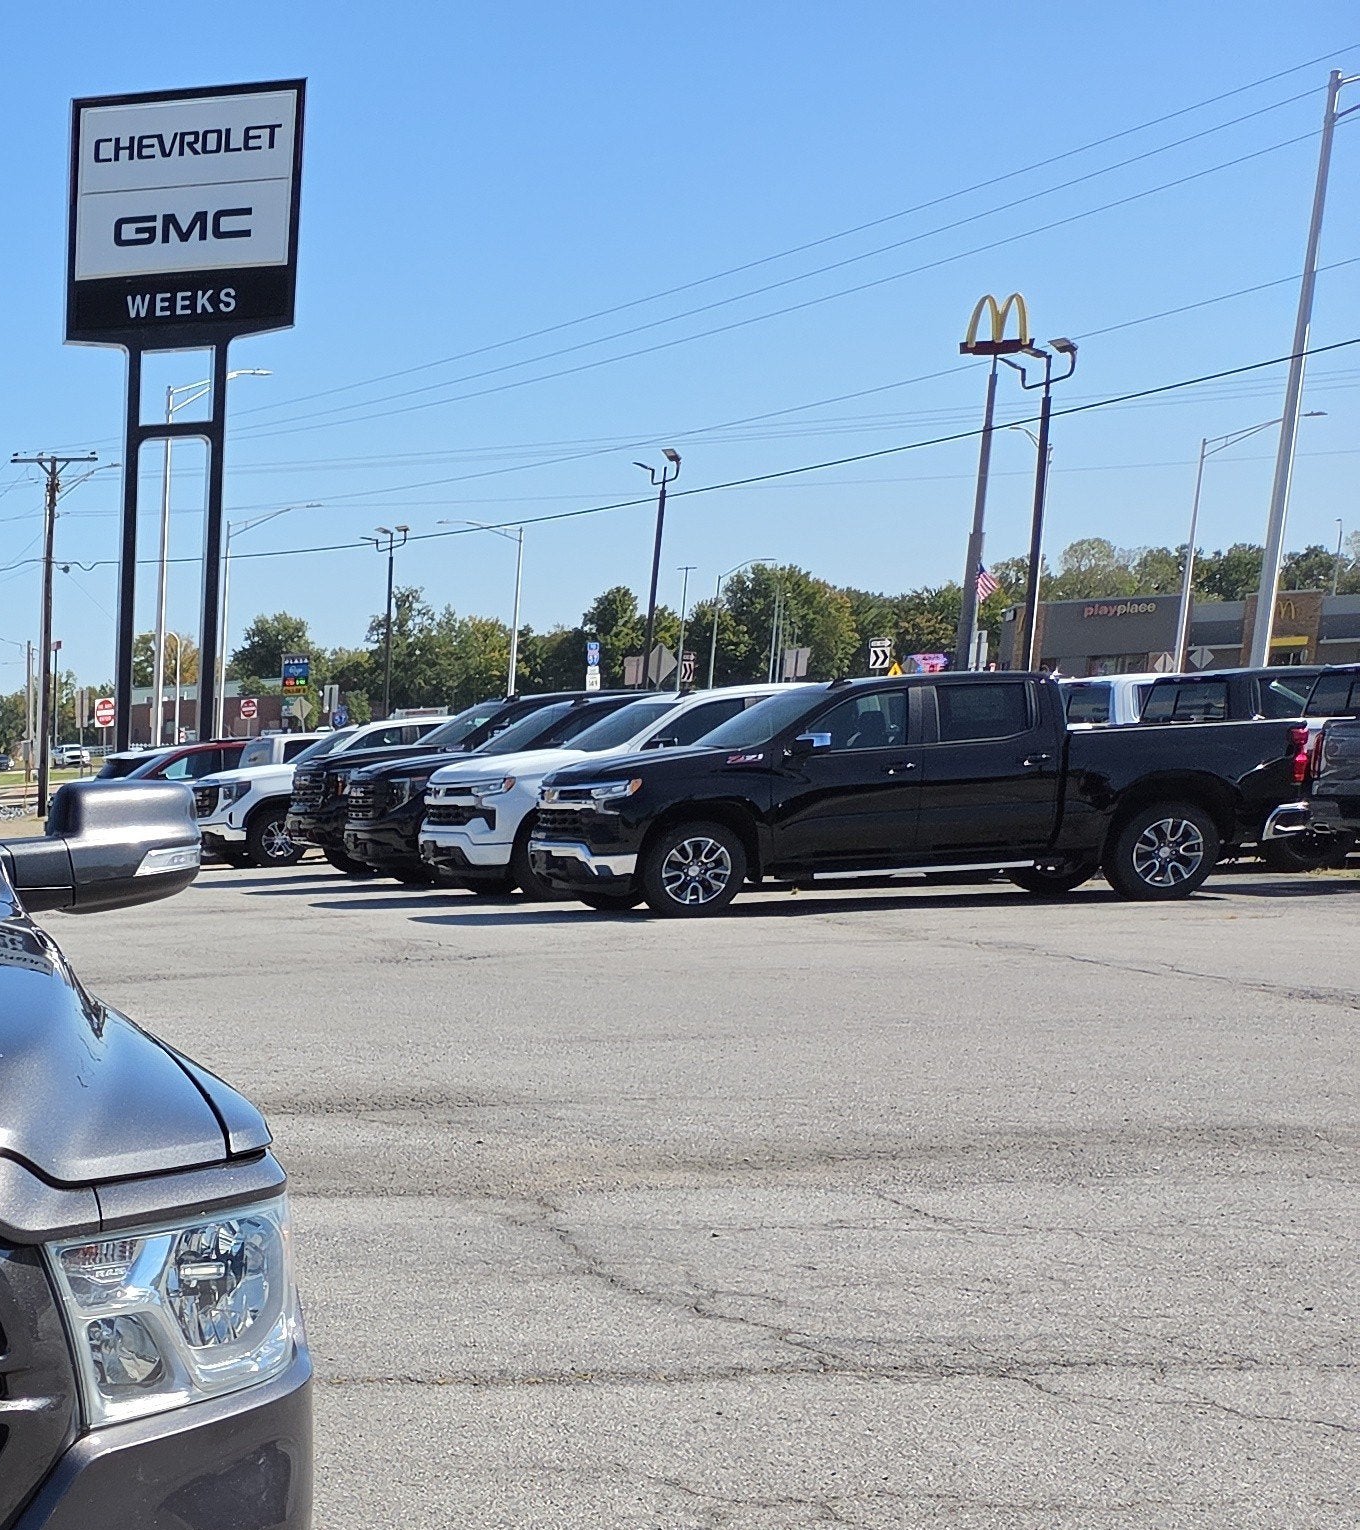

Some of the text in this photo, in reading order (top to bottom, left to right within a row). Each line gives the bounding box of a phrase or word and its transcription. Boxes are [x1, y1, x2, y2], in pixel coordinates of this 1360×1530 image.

[93, 123, 283, 163] CHEVROLET
[113, 206, 253, 247] GMC
[126, 287, 237, 318] WEEKS
[1083, 601, 1156, 618] playplace
